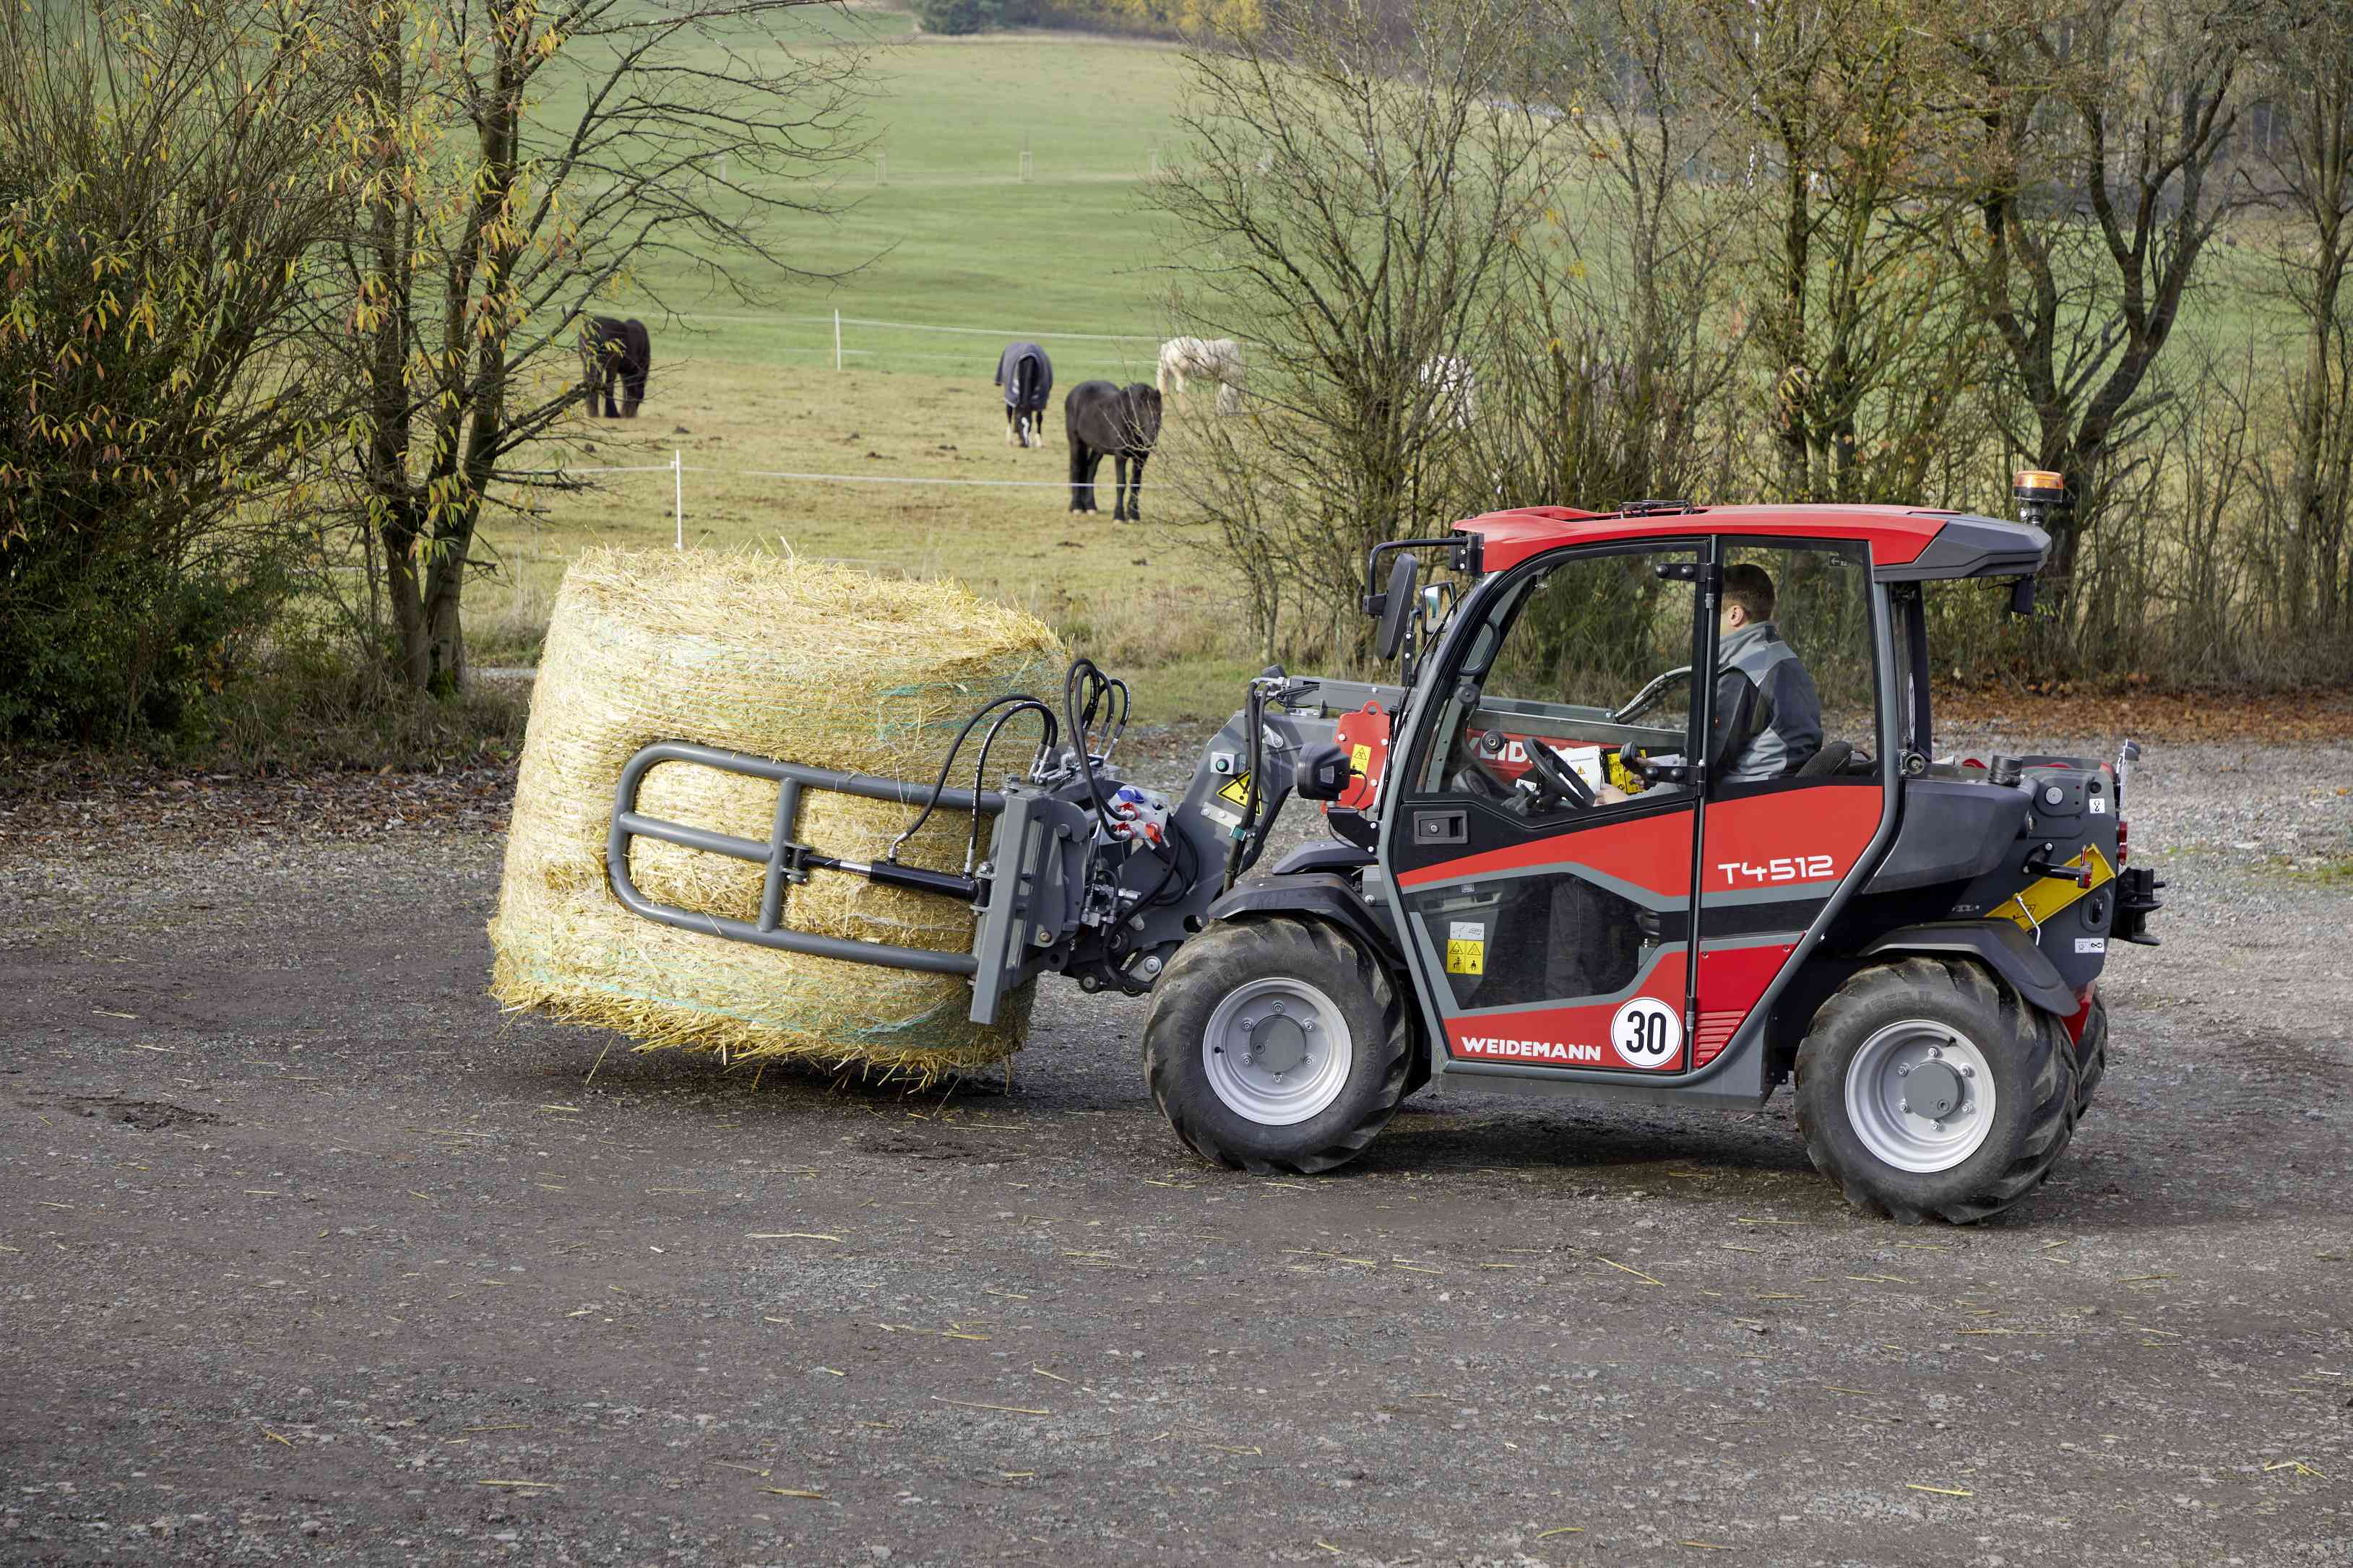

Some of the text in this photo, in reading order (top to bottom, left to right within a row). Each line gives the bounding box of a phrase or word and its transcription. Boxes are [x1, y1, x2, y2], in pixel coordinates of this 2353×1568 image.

[1717, 854, 1834, 885] T4512
[1625, 1010, 1667, 1055] 30
[1461, 1036, 1601, 1061] WEIDEMANN
